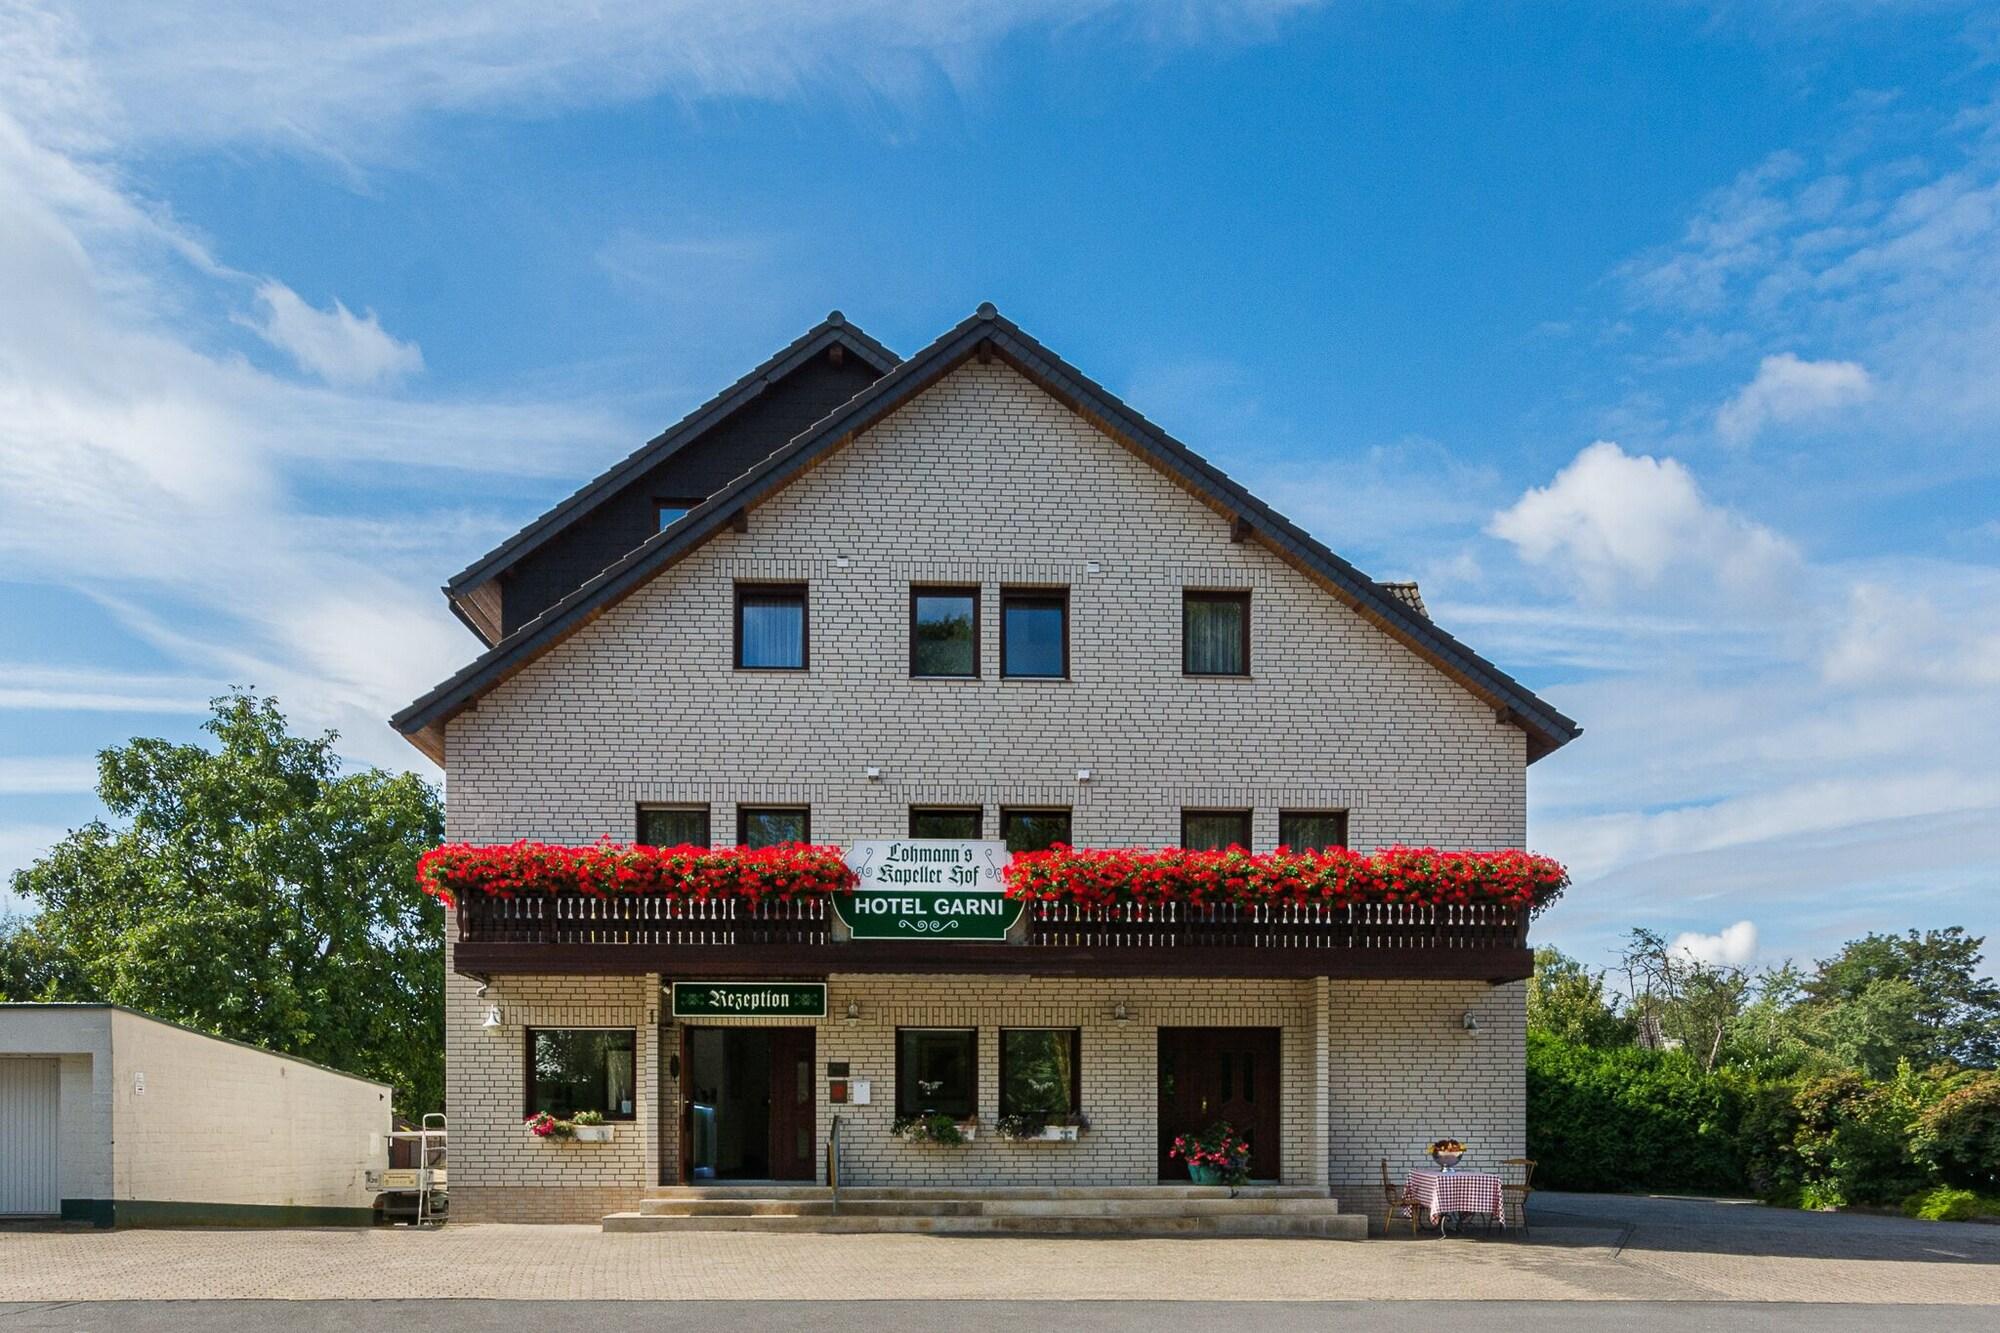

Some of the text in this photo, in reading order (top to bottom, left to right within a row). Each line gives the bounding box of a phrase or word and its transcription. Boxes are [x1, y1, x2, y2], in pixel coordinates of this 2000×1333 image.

[876, 864, 980, 886] Kapeller Hof
[855, 898, 1004, 916] HOTEL GARNI
[708, 989, 789, 1010] Rezeption
